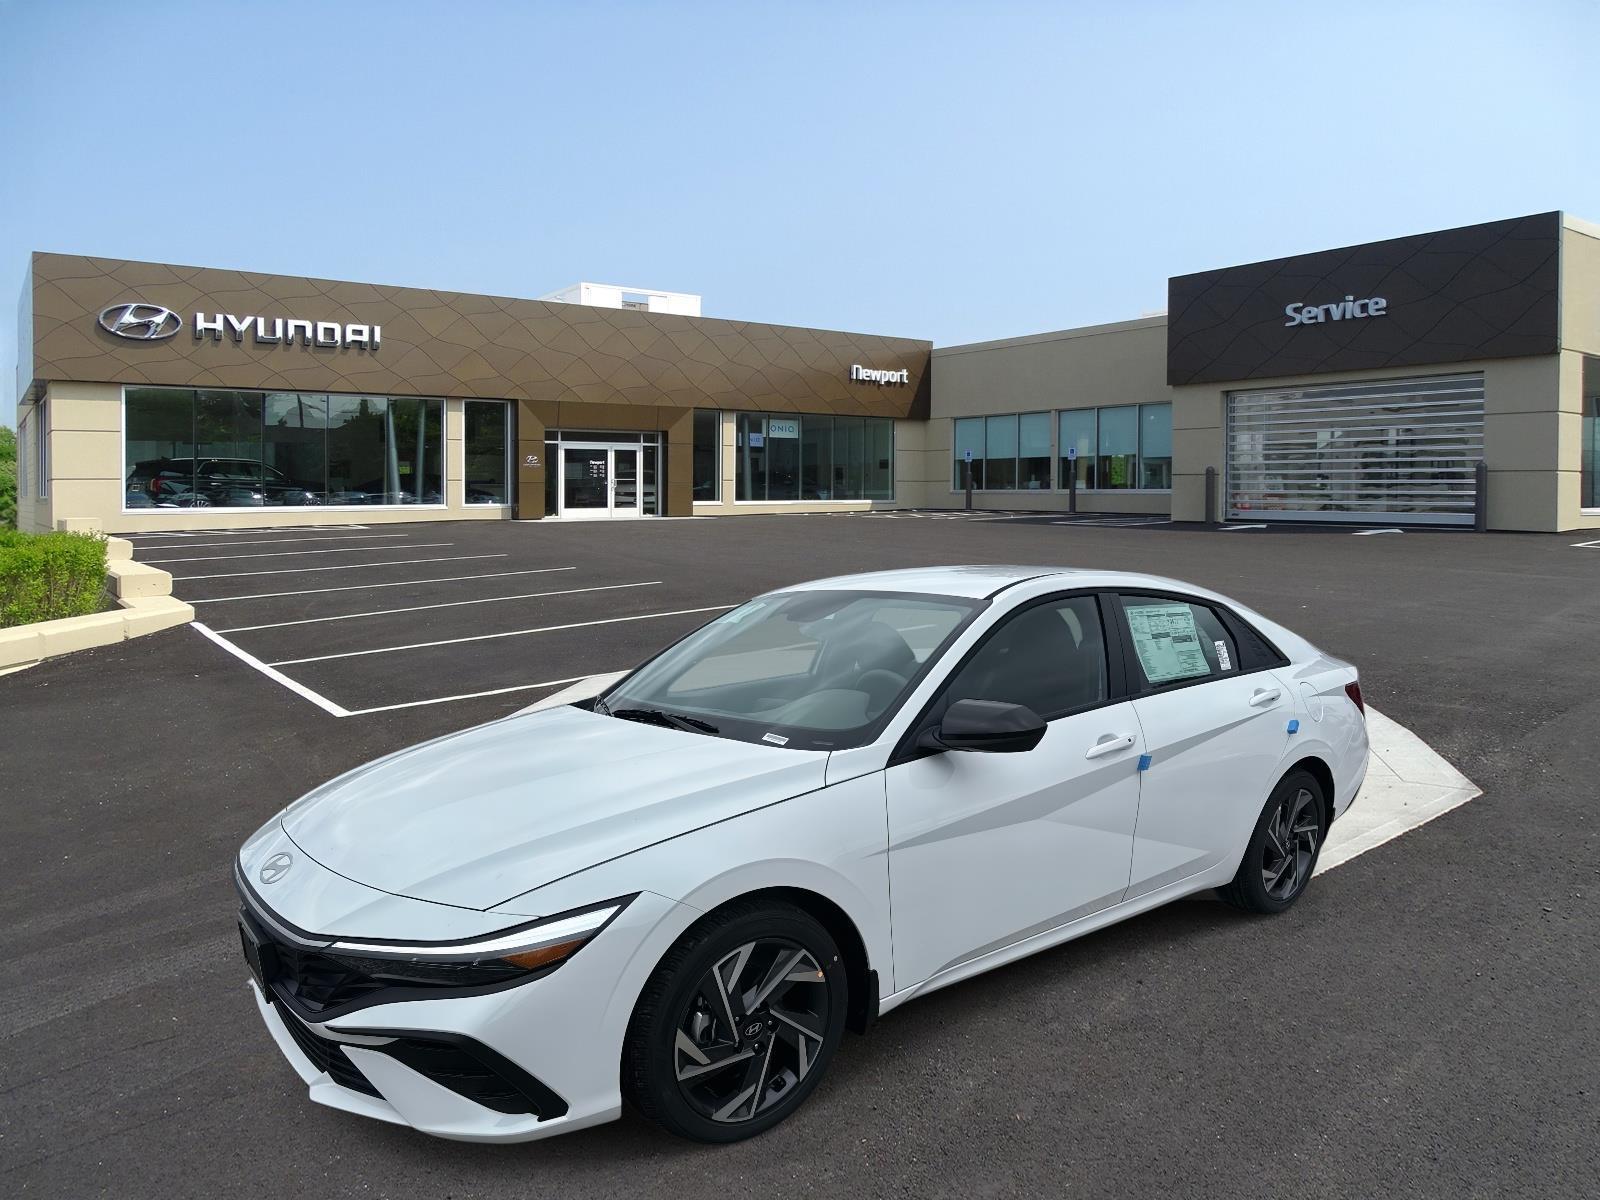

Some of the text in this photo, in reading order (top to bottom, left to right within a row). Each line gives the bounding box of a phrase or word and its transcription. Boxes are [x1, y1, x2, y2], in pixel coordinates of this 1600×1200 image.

[1284, 295, 1388, 327] Service
[194, 312, 382, 351] HYUNDAI
[850, 364, 909, 385] Newport
